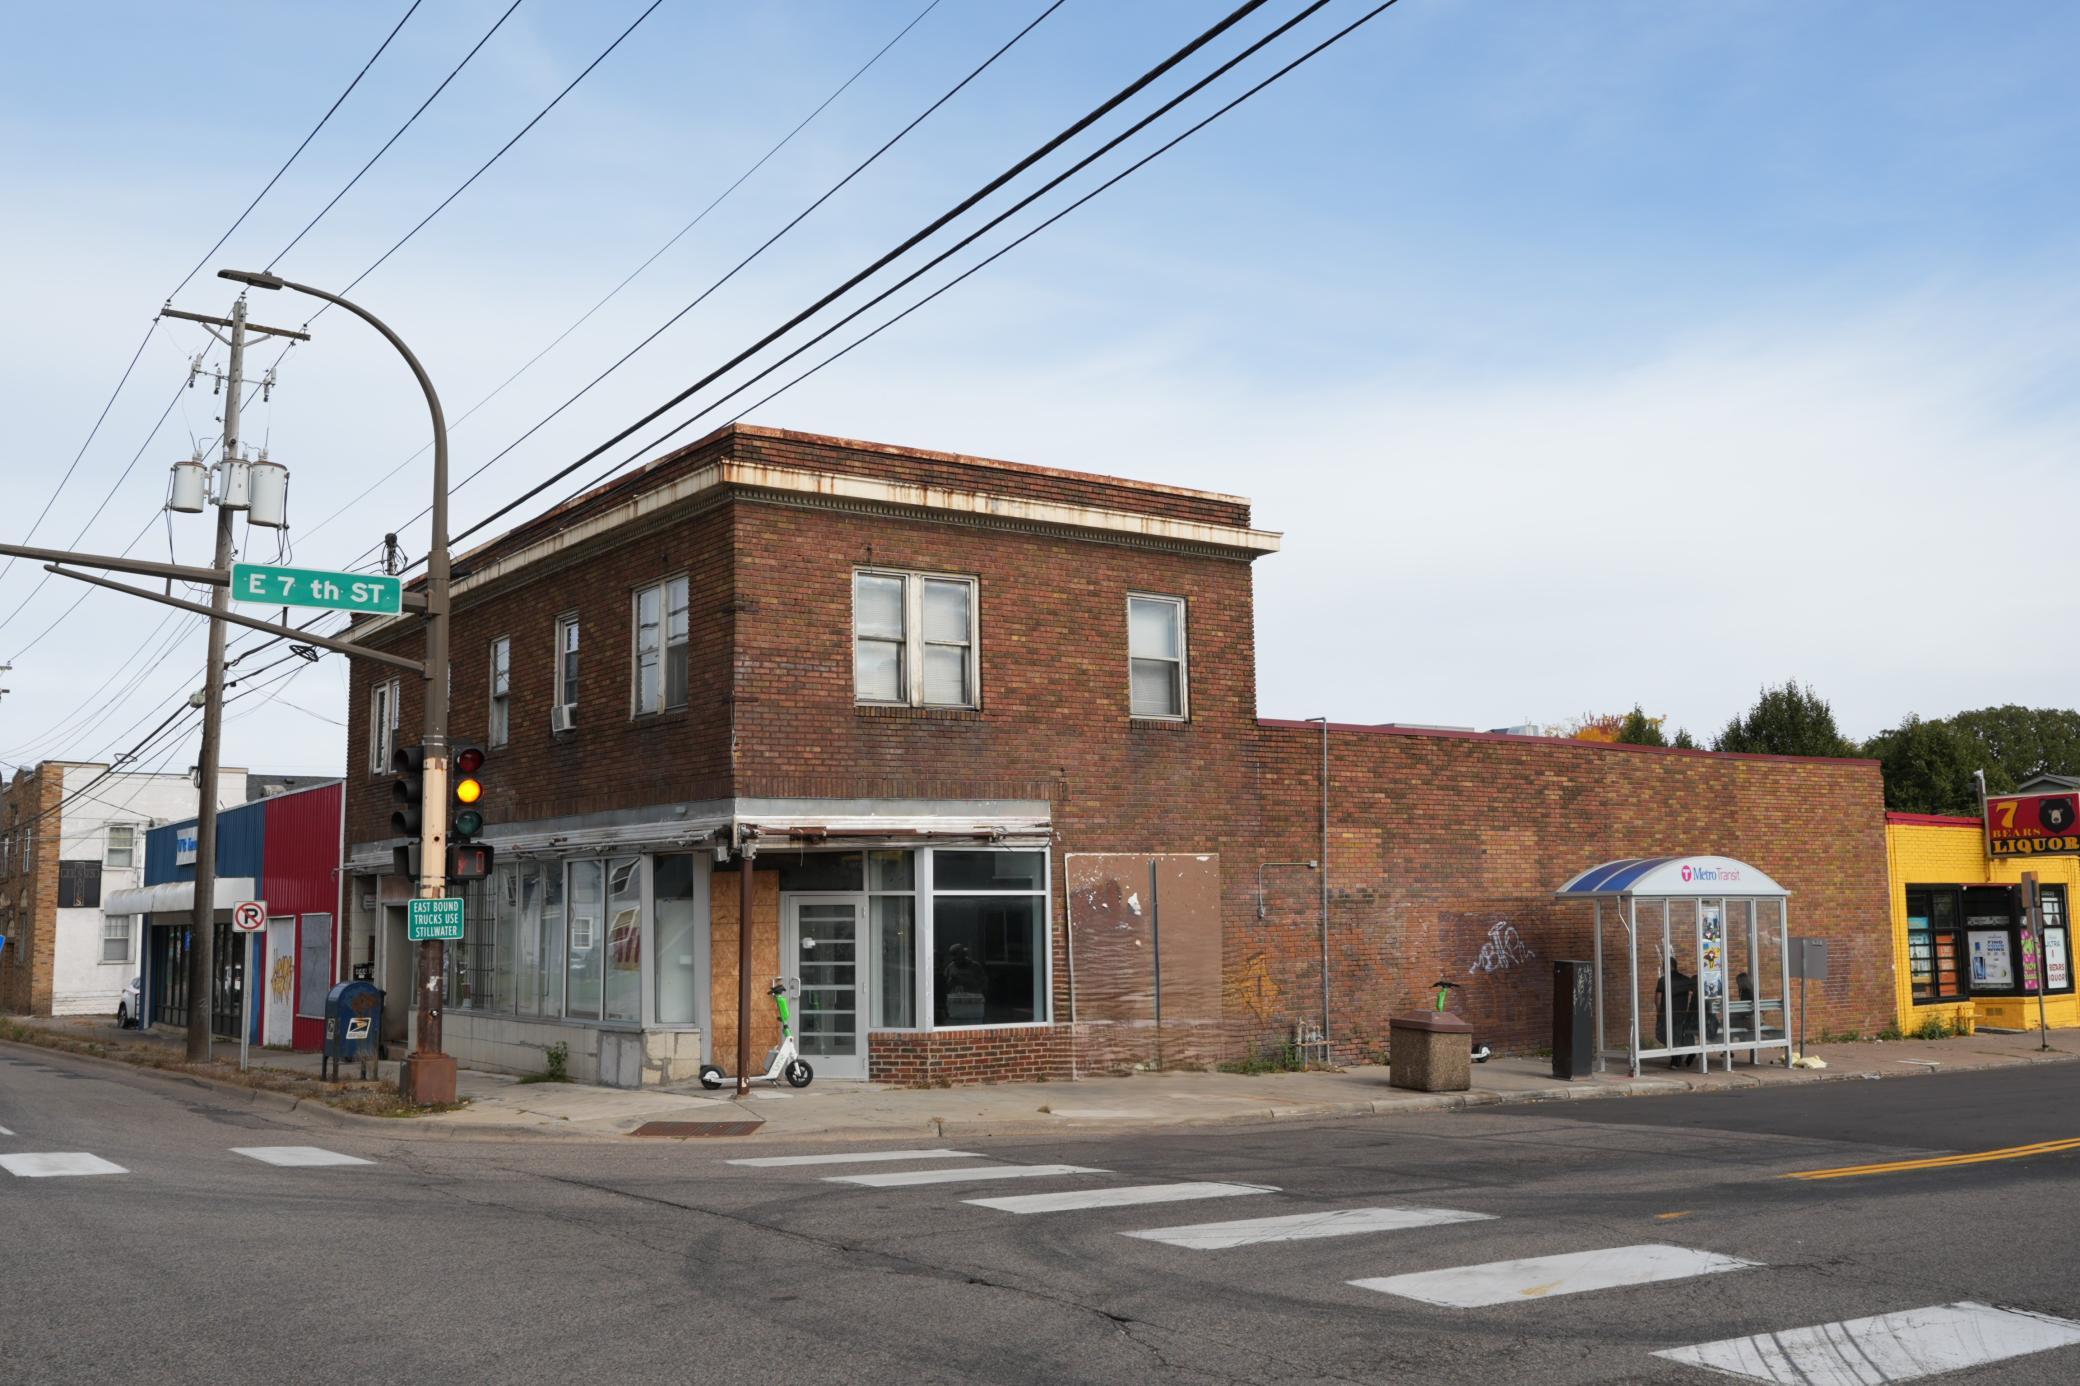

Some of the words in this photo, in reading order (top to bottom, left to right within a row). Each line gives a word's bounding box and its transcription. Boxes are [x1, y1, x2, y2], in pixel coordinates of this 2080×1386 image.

[250, 573, 267, 595] E
[277, 576, 296, 597] 7
[310, 579, 339, 600] th
[350, 582, 385, 604] ST
[1996, 801, 2018, 829] 7
[1992, 828, 2041, 838] BEARS
[1992, 836, 2080, 854] LIQUOR
[413, 902, 430, 913] EAST
[433, 901, 459, 912] BOUND
[414, 914, 443, 925] TRUCKS
[445, 913, 459, 924] USE
[415, 926, 458, 938] STILLWATER
